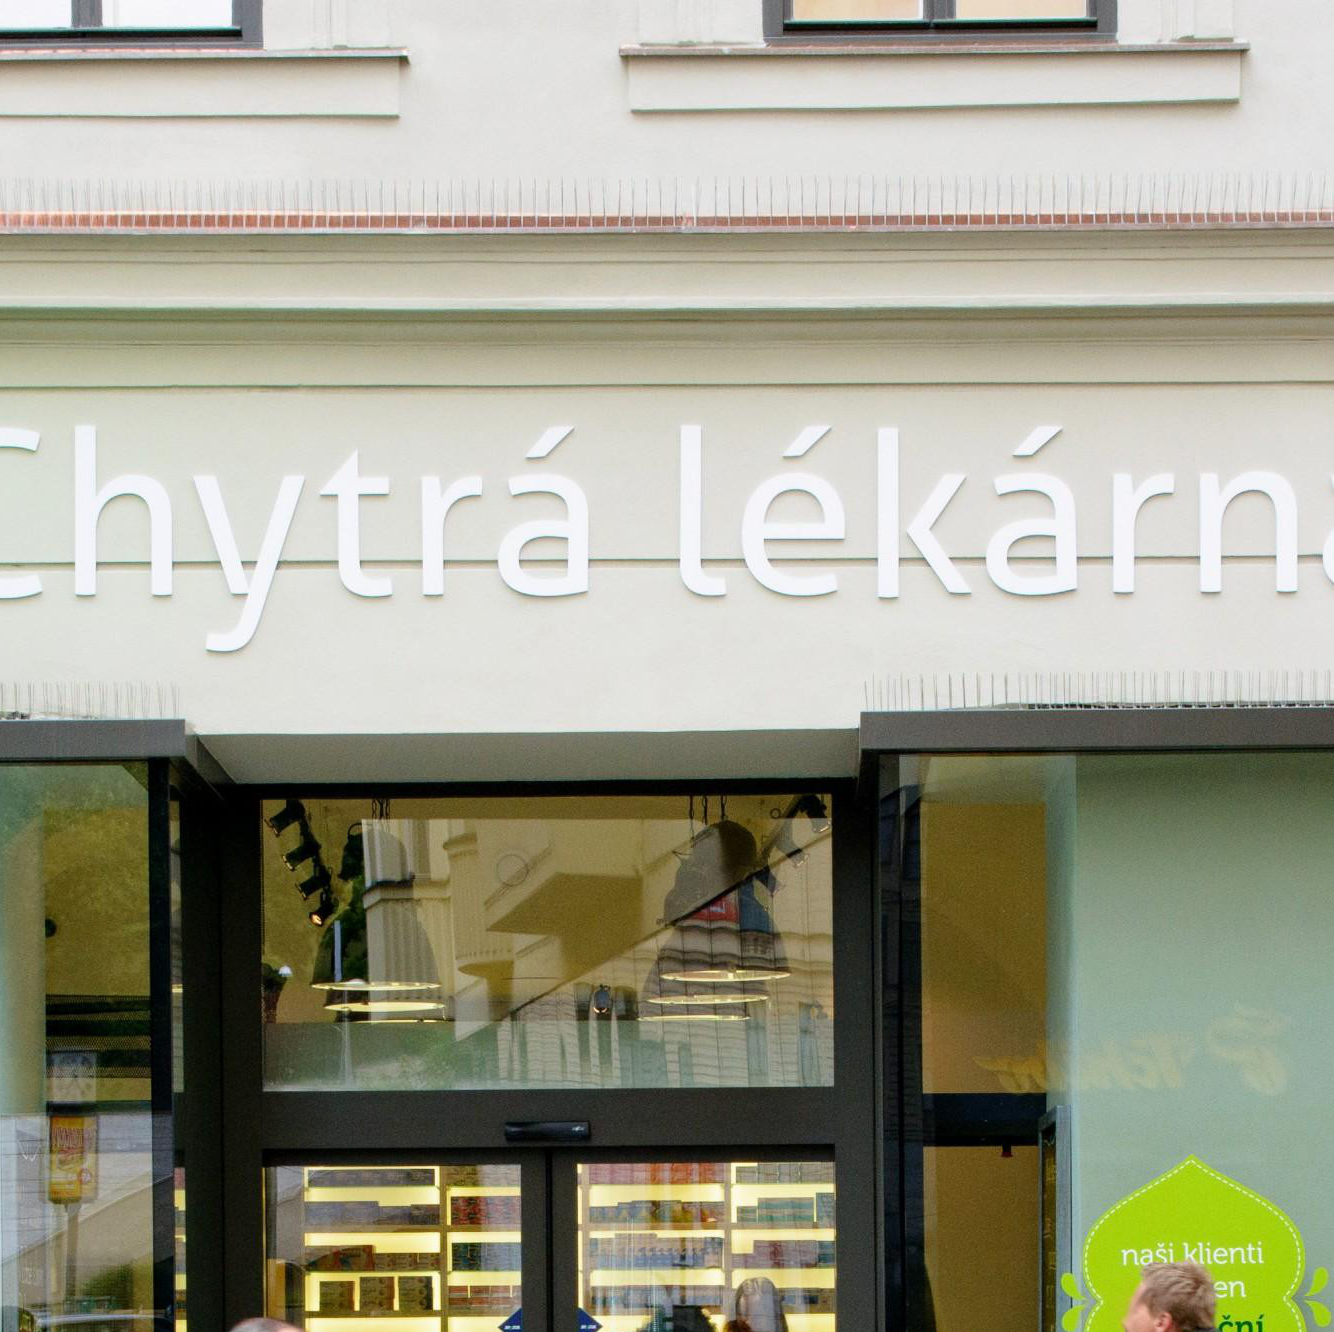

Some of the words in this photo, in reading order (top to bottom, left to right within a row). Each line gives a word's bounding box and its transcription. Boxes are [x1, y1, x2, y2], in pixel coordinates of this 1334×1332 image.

[1120, 1241, 1174, 1266] naši
[1182, 1240, 1265, 1265] klienti
[1215, 1279, 1246, 1298] en
